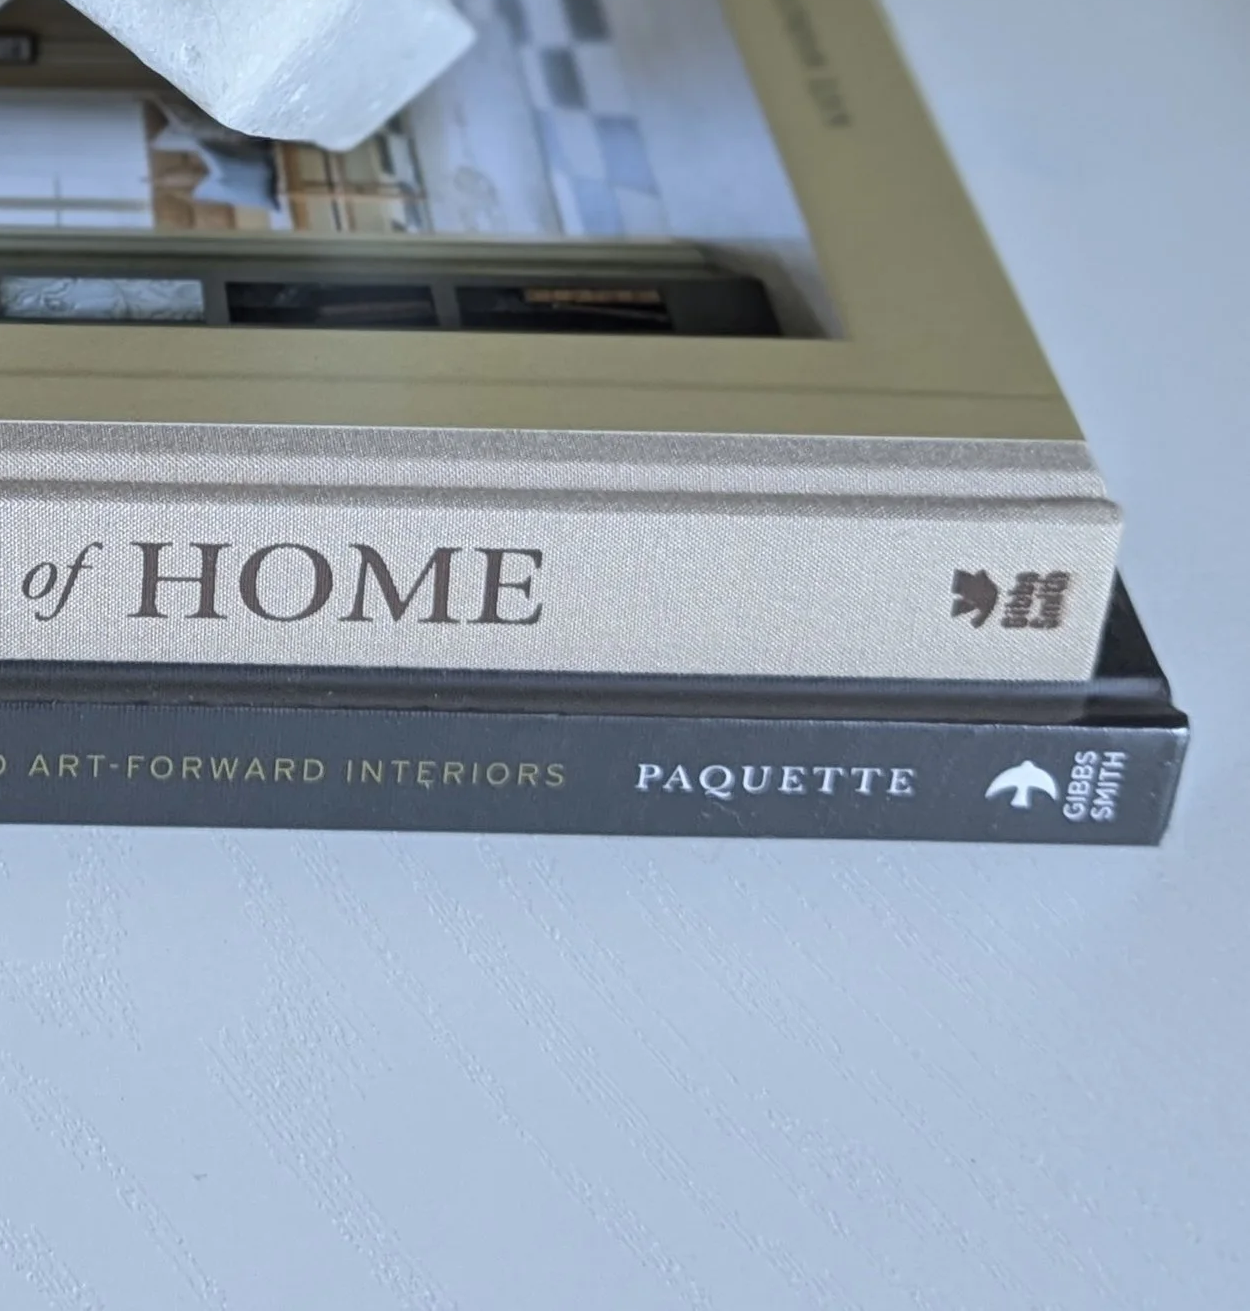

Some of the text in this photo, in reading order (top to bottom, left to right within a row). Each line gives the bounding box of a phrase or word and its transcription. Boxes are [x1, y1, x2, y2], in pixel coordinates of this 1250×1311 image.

[20, 540, 105, 623] of
[126, 540, 544, 627] HOME
[27, 753, 327, 784] ART-FORWARD
[345, 759, 566, 790] INTERIORS
[636, 763, 916, 800] PAQUETTE
[1062, 750, 1097, 821] GIBBS
[1090, 750, 1127, 822] SMITH
